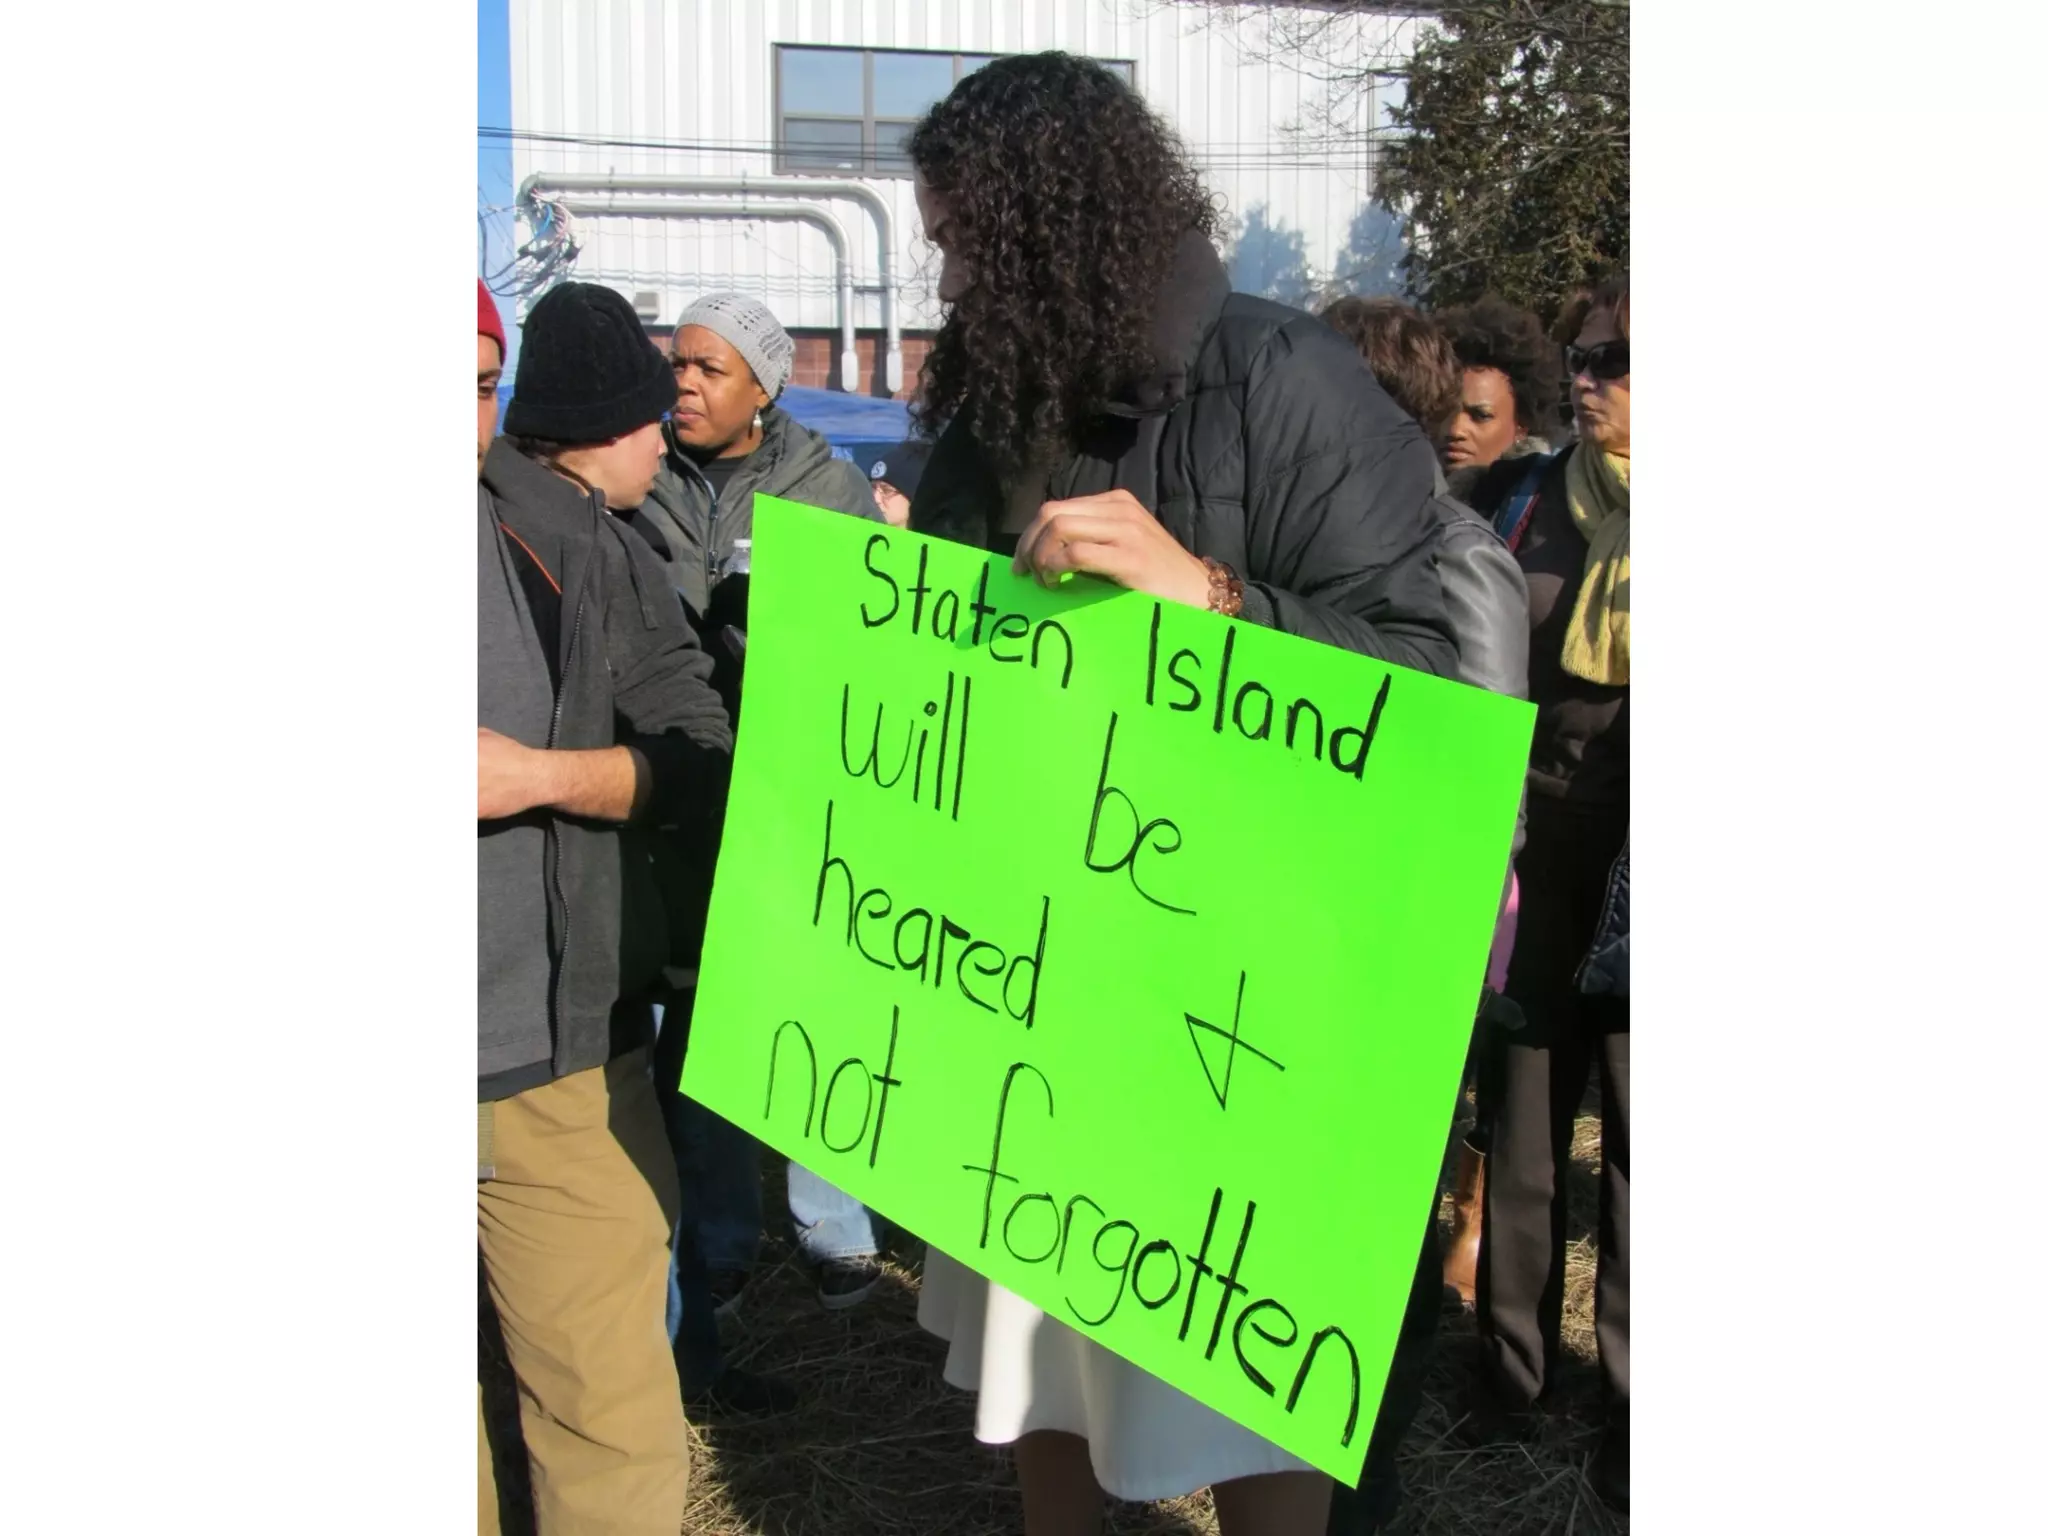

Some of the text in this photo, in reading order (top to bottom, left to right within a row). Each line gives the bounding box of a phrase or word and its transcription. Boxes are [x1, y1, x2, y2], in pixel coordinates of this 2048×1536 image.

[861, 535, 1392, 780] Staten Island
[814, 800, 1050, 1030] heared
[842, 671, 1197, 915] will be
[764, 1005, 1361, 1448] not forgotten
